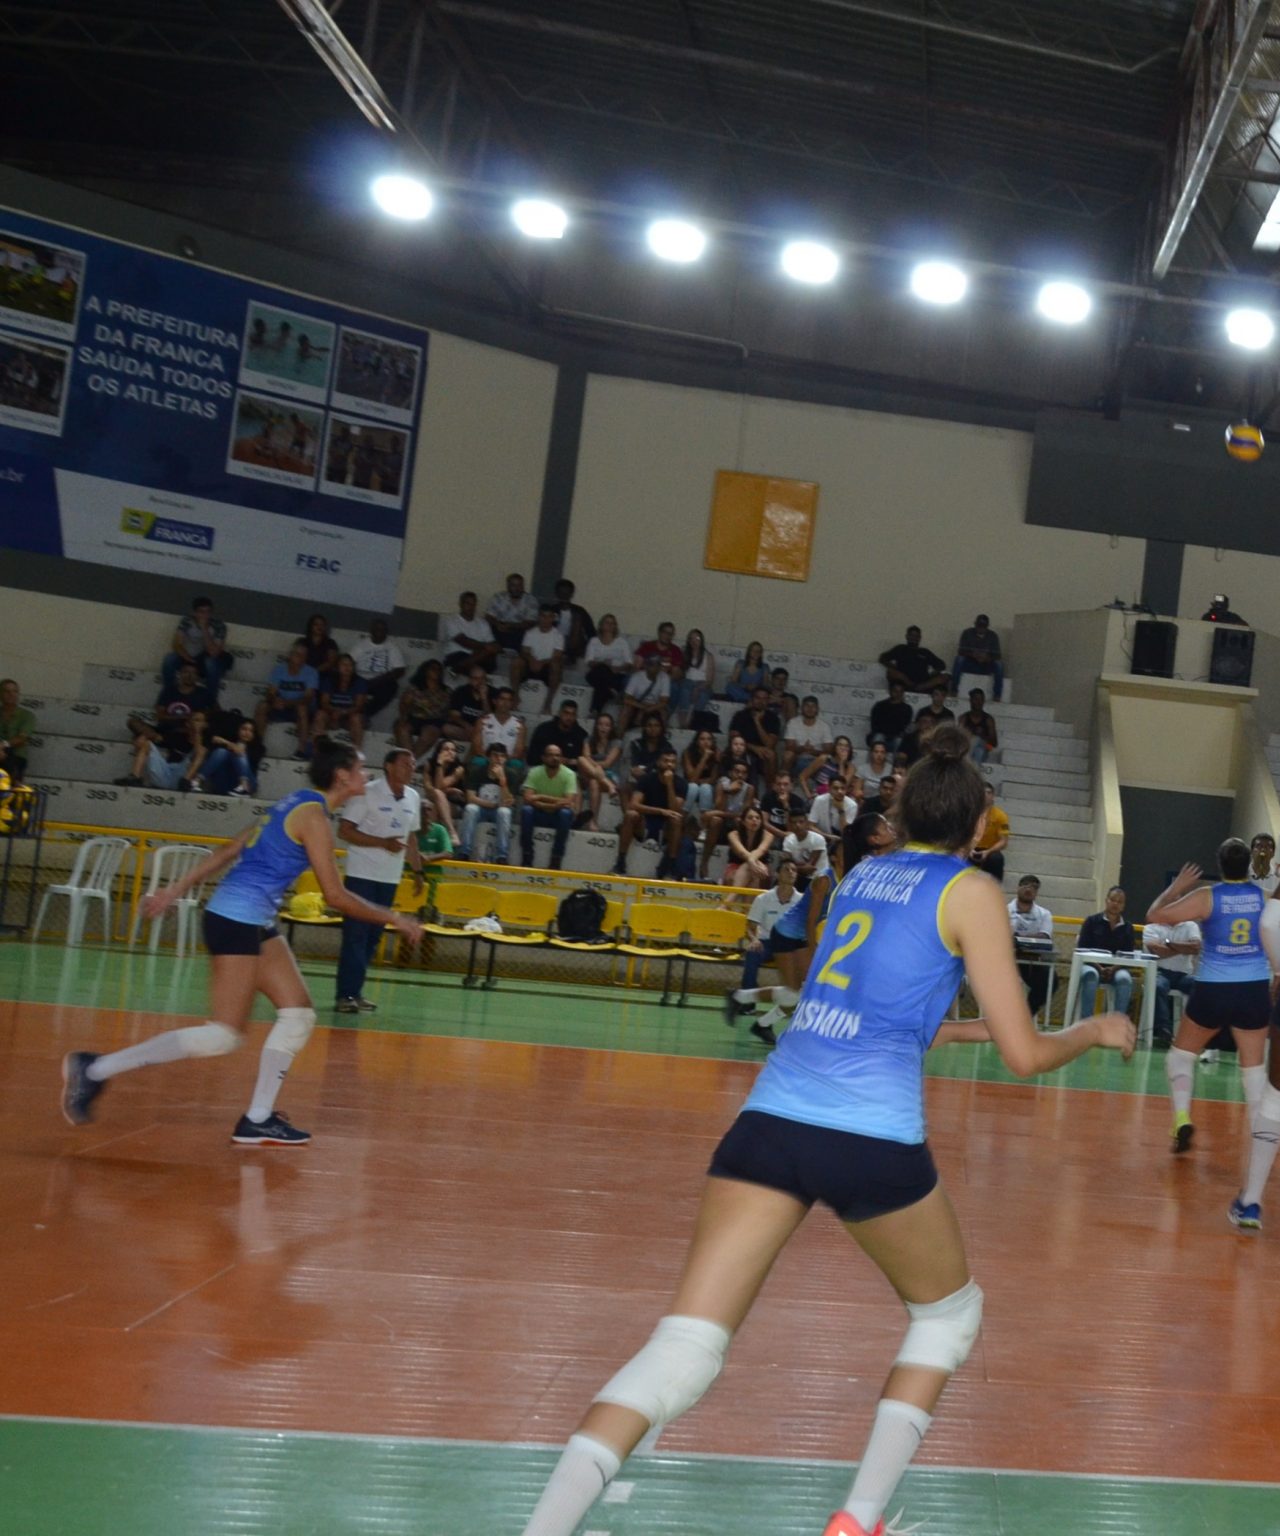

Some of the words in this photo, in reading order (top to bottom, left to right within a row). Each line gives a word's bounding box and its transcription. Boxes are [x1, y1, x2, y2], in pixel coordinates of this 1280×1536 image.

[84, 296, 102, 314] A
[106, 300, 240, 350] PREFEITURA
[93, 324, 126, 347] DA
[131, 333, 225, 373] FRANCA
[78, 346, 156, 381] SAÚDA
[160, 365, 233, 398] TODOS
[87, 374, 120, 396] OS
[123, 384, 219, 420] ATLETAS
[153, 527, 209, 548] FRANCA
[295, 553, 342, 574] FEAC
[86, 789, 118, 802] 393
[142, 794, 176, 807] 394
[197, 800, 228, 813] 395
[586, 836, 617, 849] 402
[853, 881, 914, 906] FRANCA
[1230, 918, 1251, 944] 8
[816, 910, 874, 991] 2
